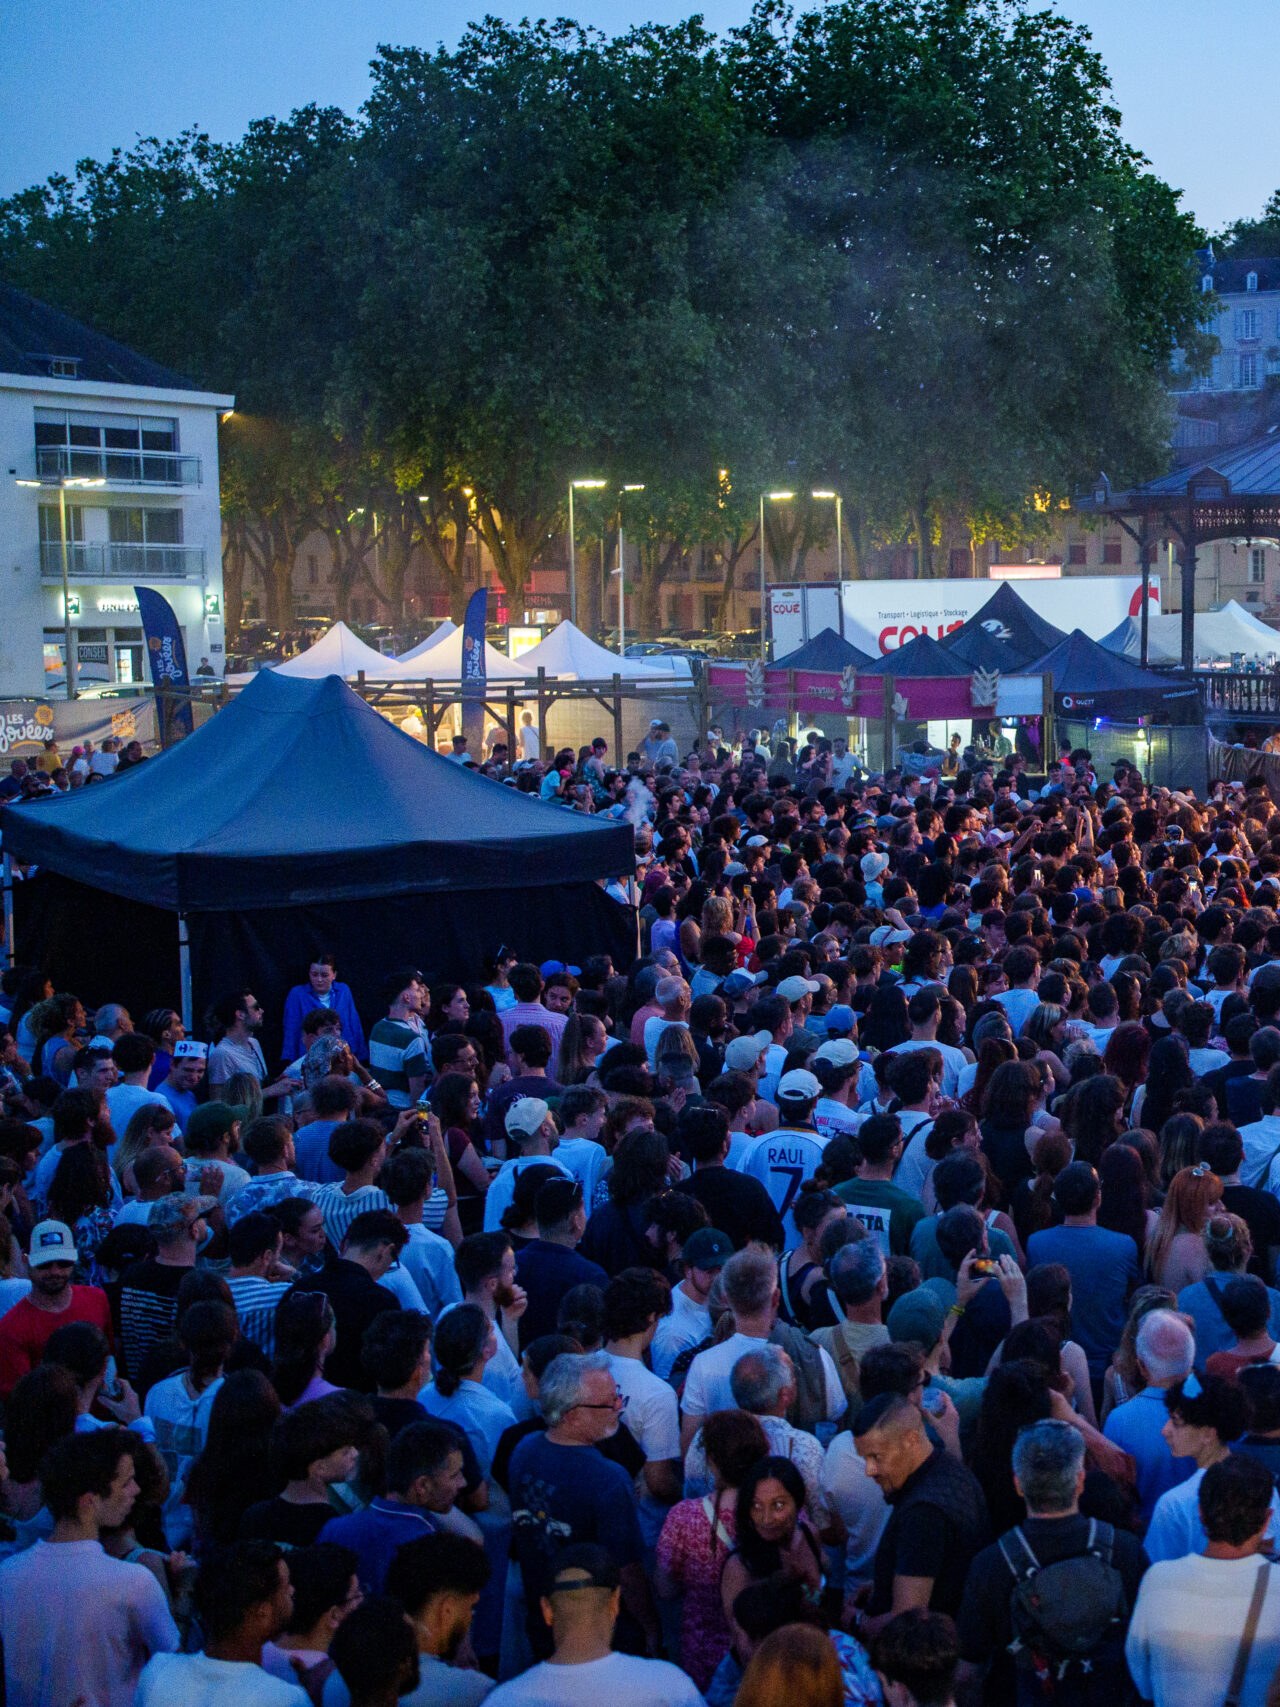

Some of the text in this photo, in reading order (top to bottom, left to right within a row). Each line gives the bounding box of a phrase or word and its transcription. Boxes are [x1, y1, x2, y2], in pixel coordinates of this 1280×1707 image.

[878, 609, 968, 619] Transport Logistique Stockage
[79, 646, 106, 658] CONSEIL
[7, 714, 24, 725] LES
[768, 1147, 805, 1165] RAUL
[770, 1166, 803, 1219] 7
